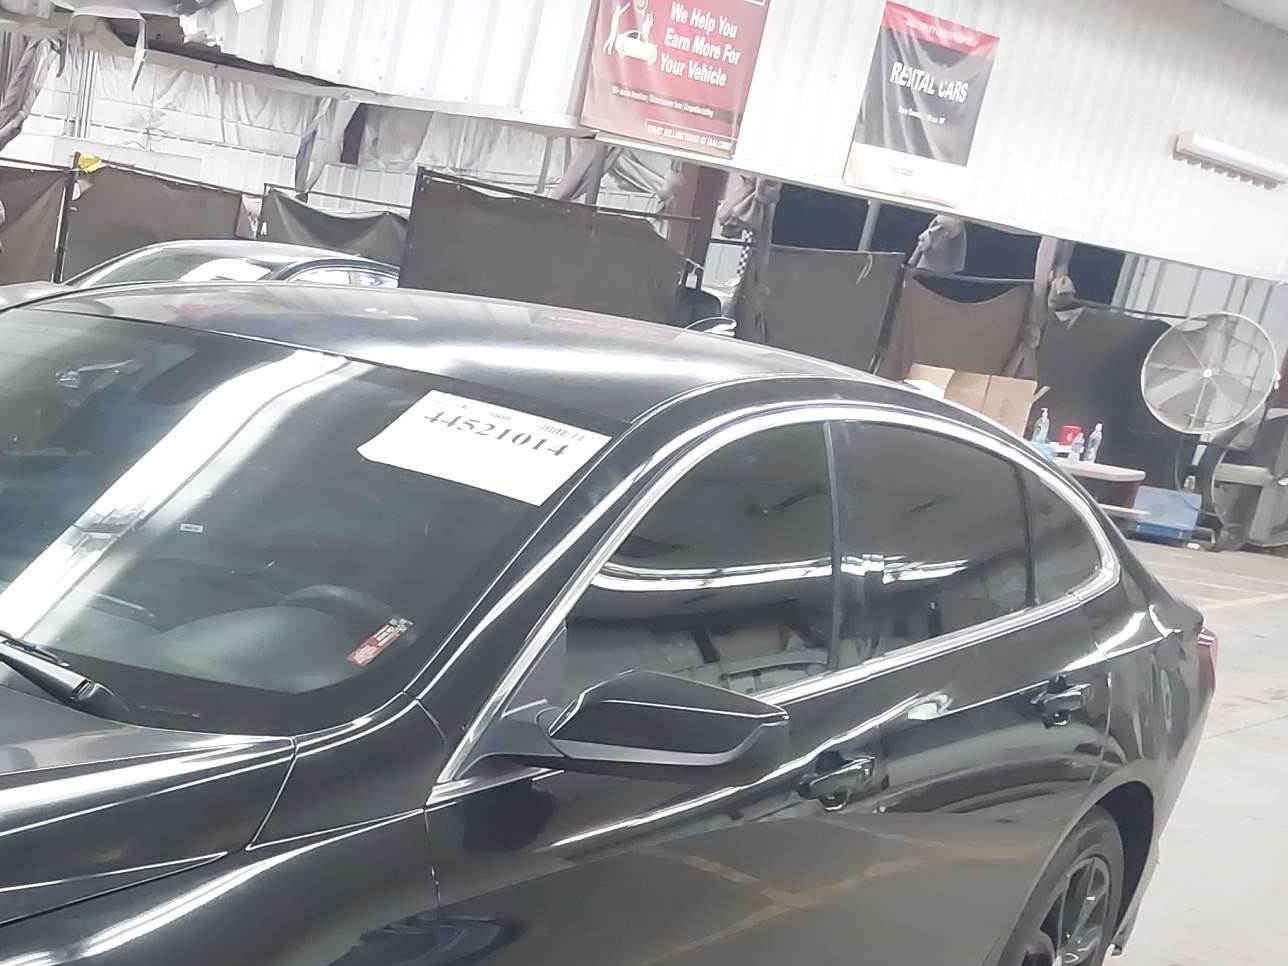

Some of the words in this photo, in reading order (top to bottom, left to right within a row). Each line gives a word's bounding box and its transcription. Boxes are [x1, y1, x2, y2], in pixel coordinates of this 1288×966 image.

[671, 2, 688, 24] We
[690, 10, 715, 35] Help
[719, 13, 738, 39] You
[665, 28, 690, 50] Earn
[692, 35, 720, 60] More
[723, 43, 741, 65] For
[661, 52, 685, 77] Your
[688, 60, 728, 87] Vehicle
[890, 61, 936, 95] RENTAL
[938, 80, 969, 103] CARS
[423, 411, 569, 457] 44521014
